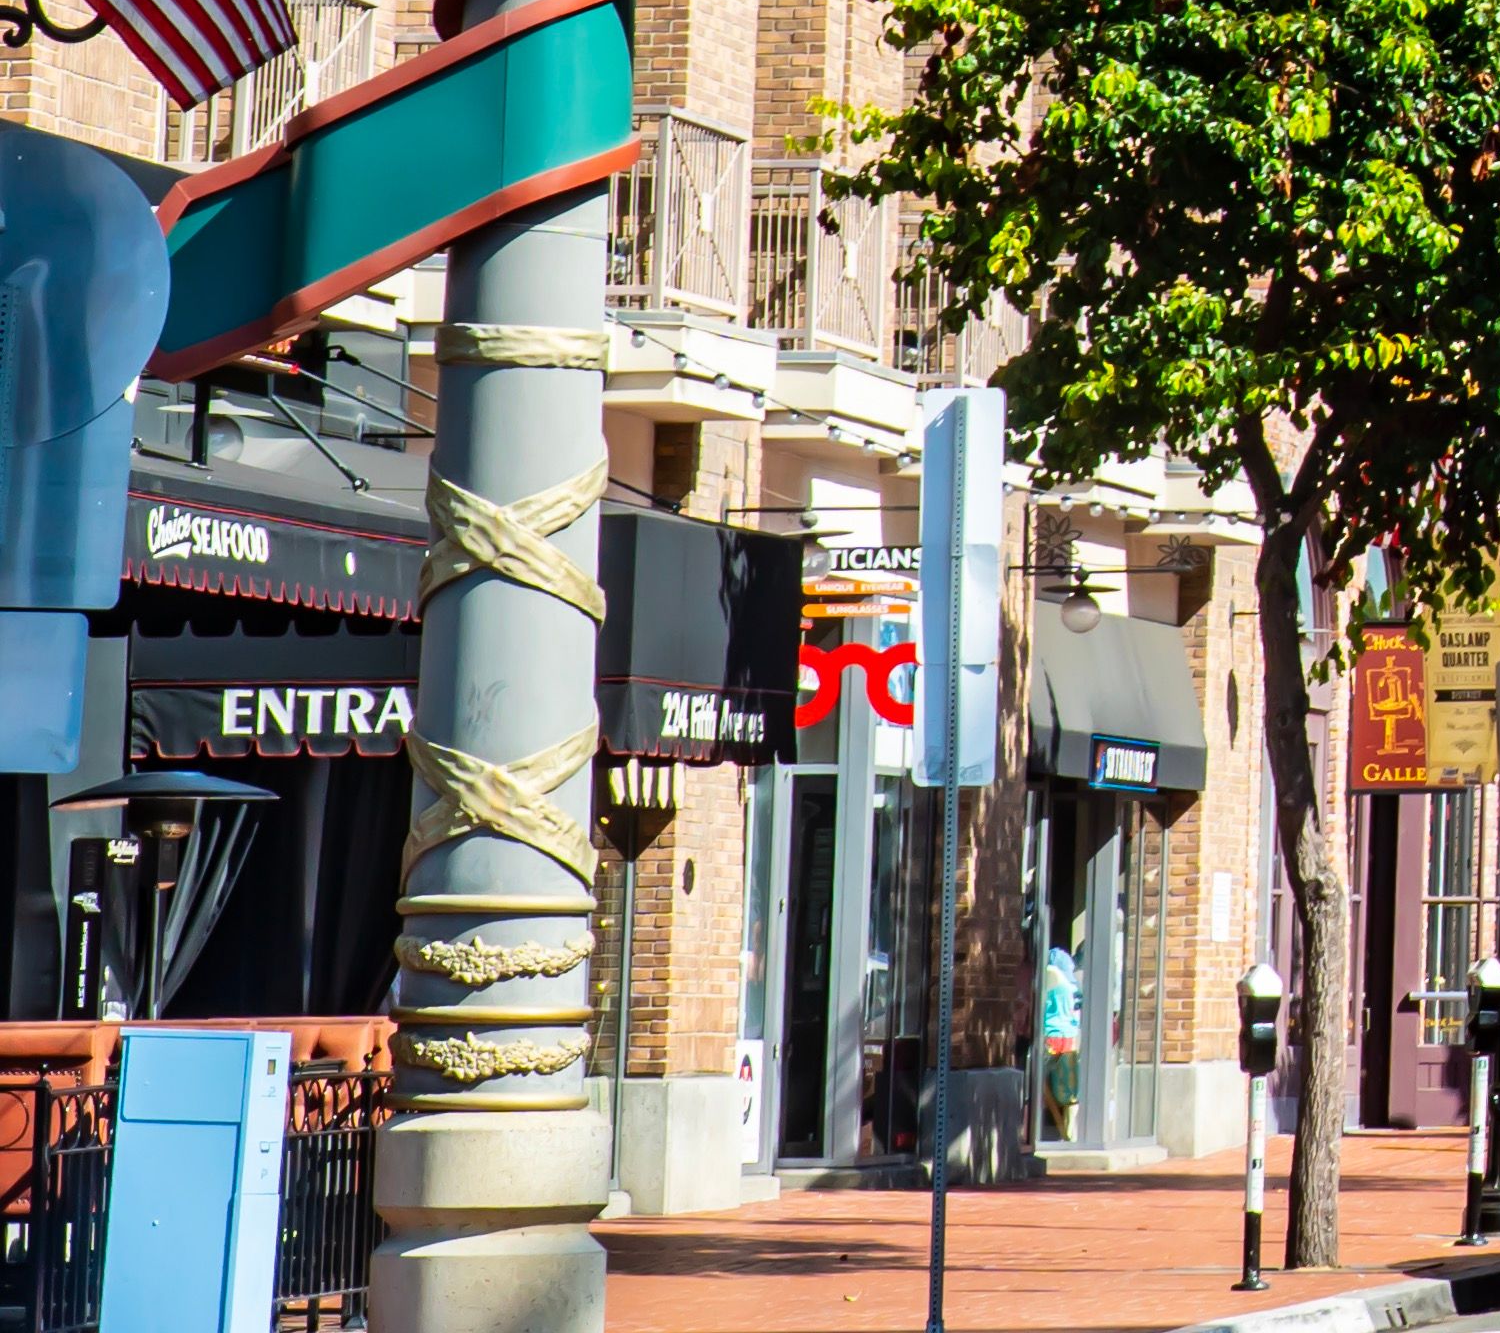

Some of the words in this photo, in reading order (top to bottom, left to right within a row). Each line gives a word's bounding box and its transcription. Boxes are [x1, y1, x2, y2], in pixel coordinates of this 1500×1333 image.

[148, 506, 192, 553] Choice
[191, 516, 270, 564] SEAFOOD
[815, 582, 855, 592] UNIQUE
[826, 603, 889, 614] SUNGLASSES
[1440, 632, 1490, 648] GASLAMP
[1442, 652, 1489, 667] QUARTER
[222, 686, 415, 736] ENTRA
[661, 691, 689, 737] 224
